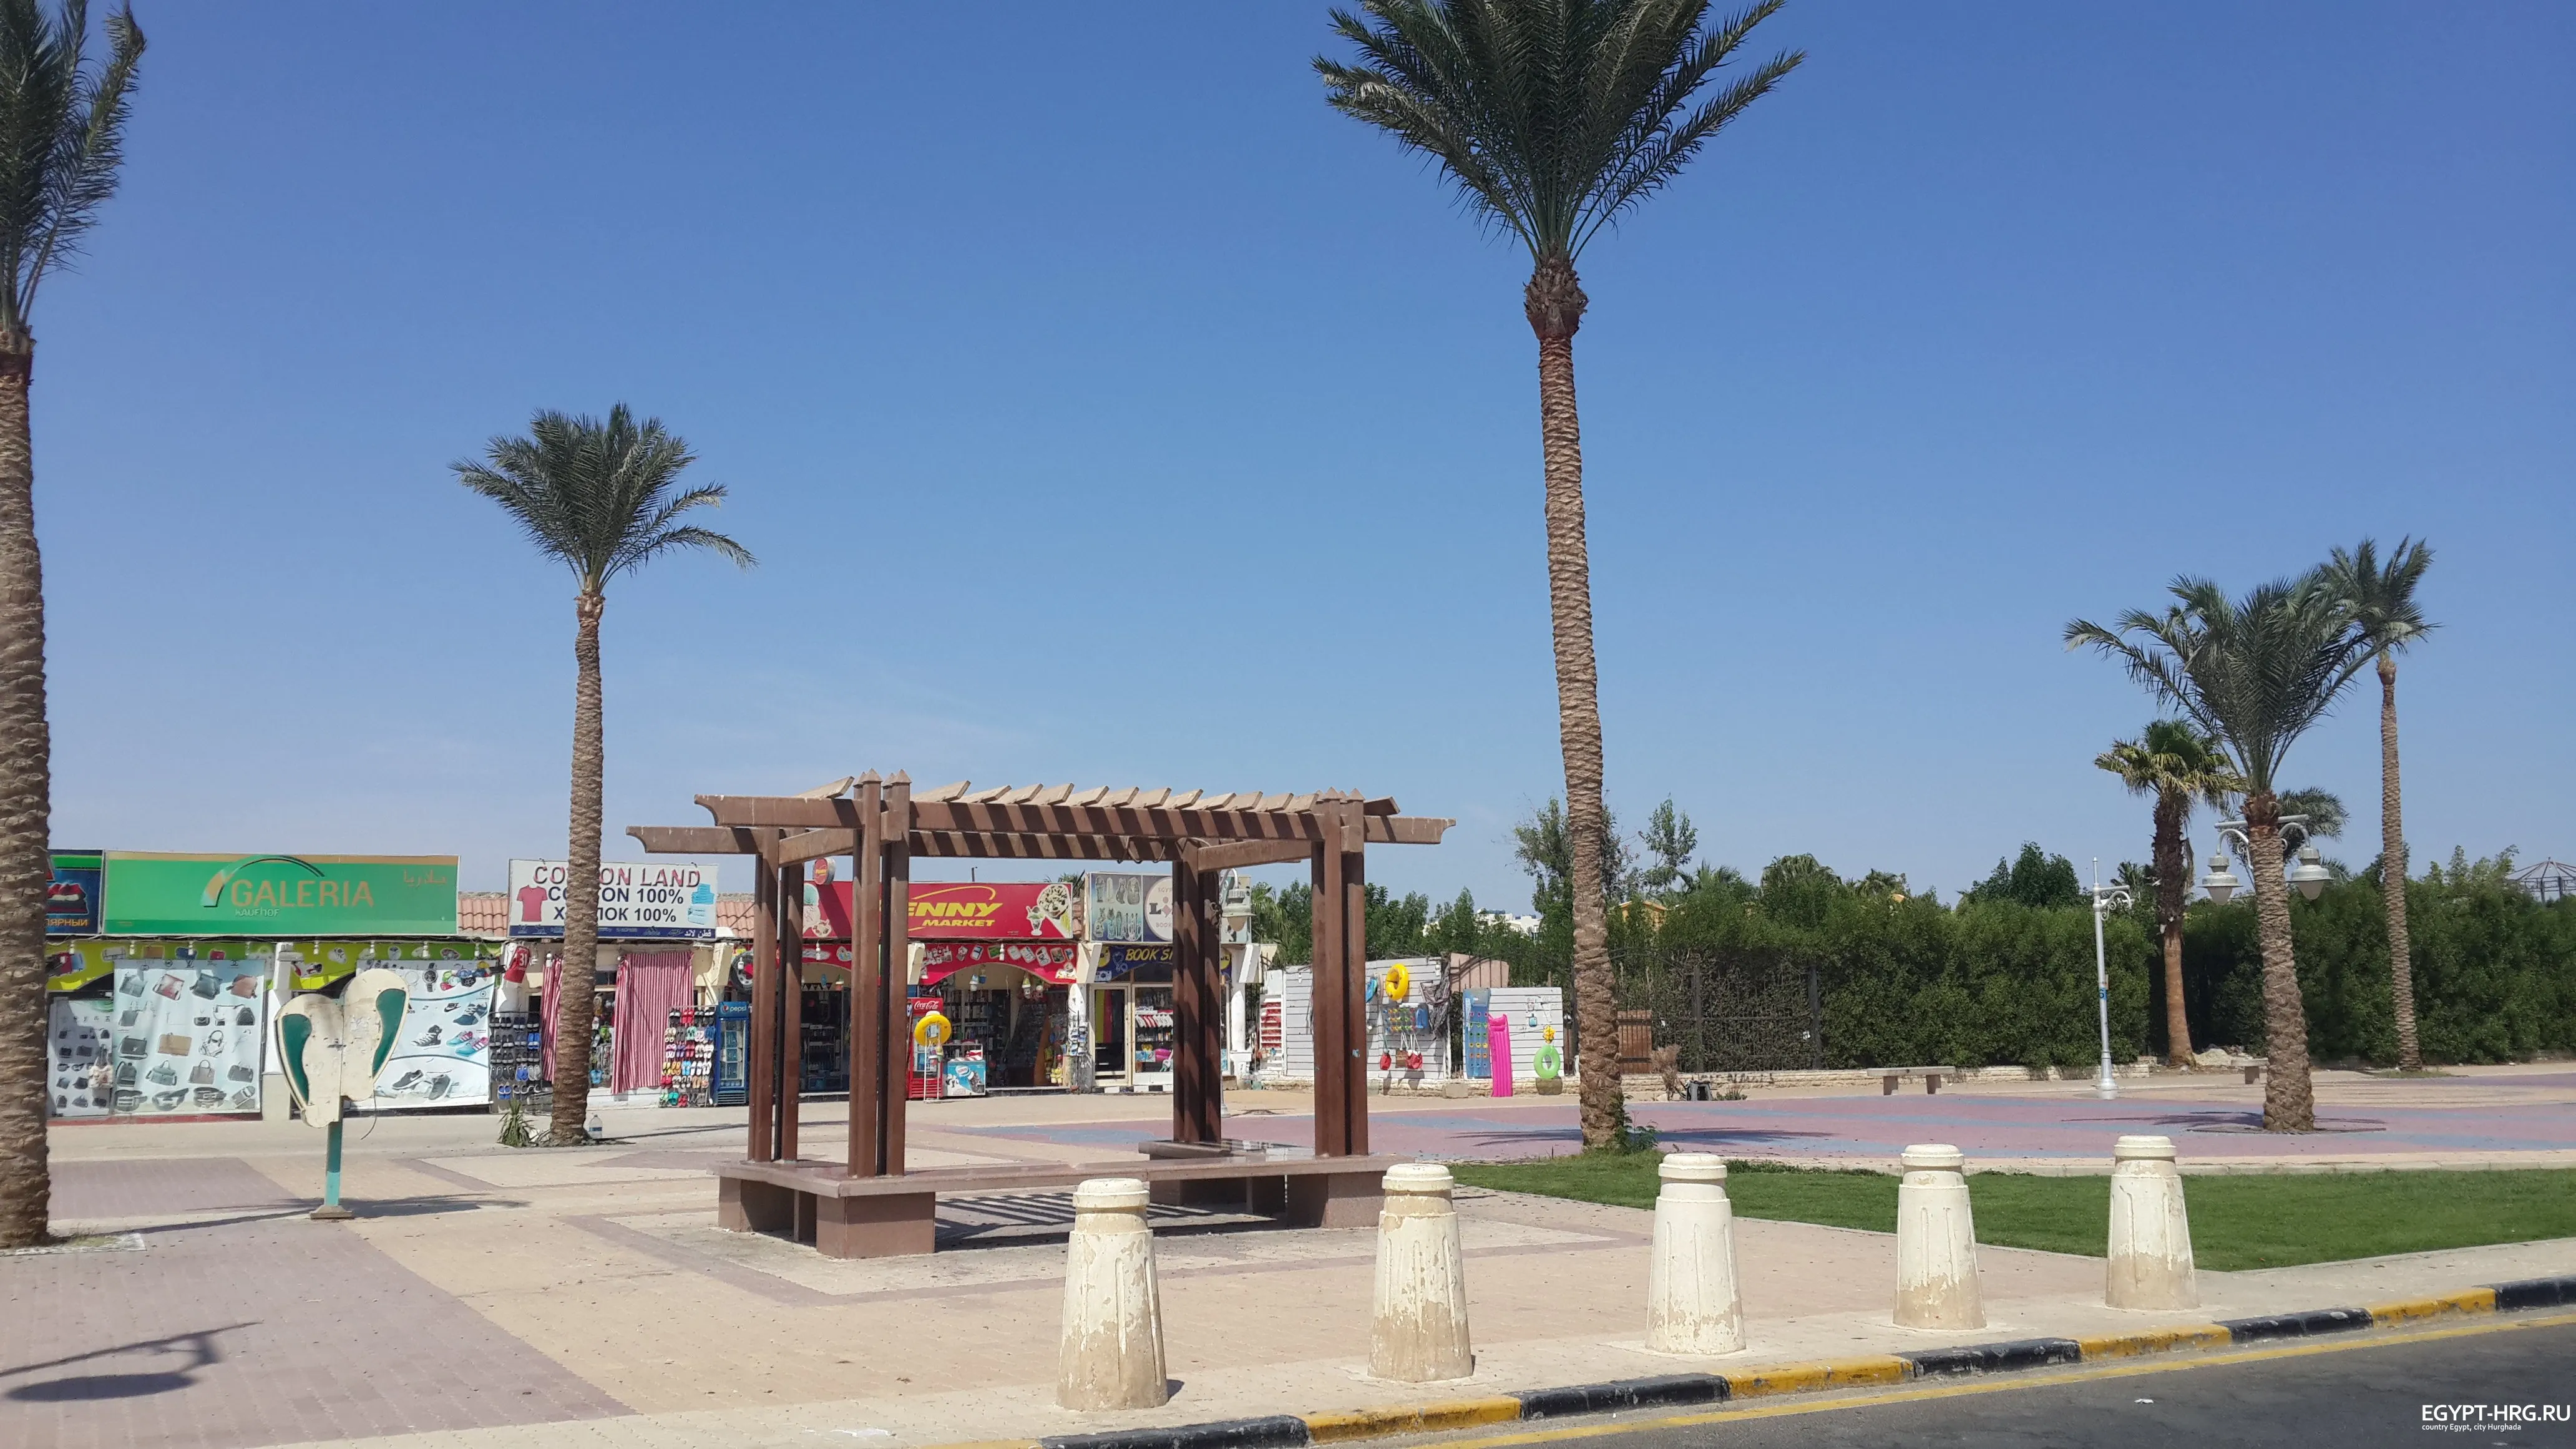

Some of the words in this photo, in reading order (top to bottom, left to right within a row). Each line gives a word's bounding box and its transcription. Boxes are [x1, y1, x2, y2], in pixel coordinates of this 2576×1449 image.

[534, 866, 632, 886] COON
[640, 868, 700, 887] LAND
[231, 879, 374, 907] GALERIA
[549, 886, 629, 902] CON
[637, 889, 684, 904] 100%
[635, 908, 676, 922] 100%
[908, 902, 1003, 917] ENNY
[1125, 949, 1160, 961] BOOK
